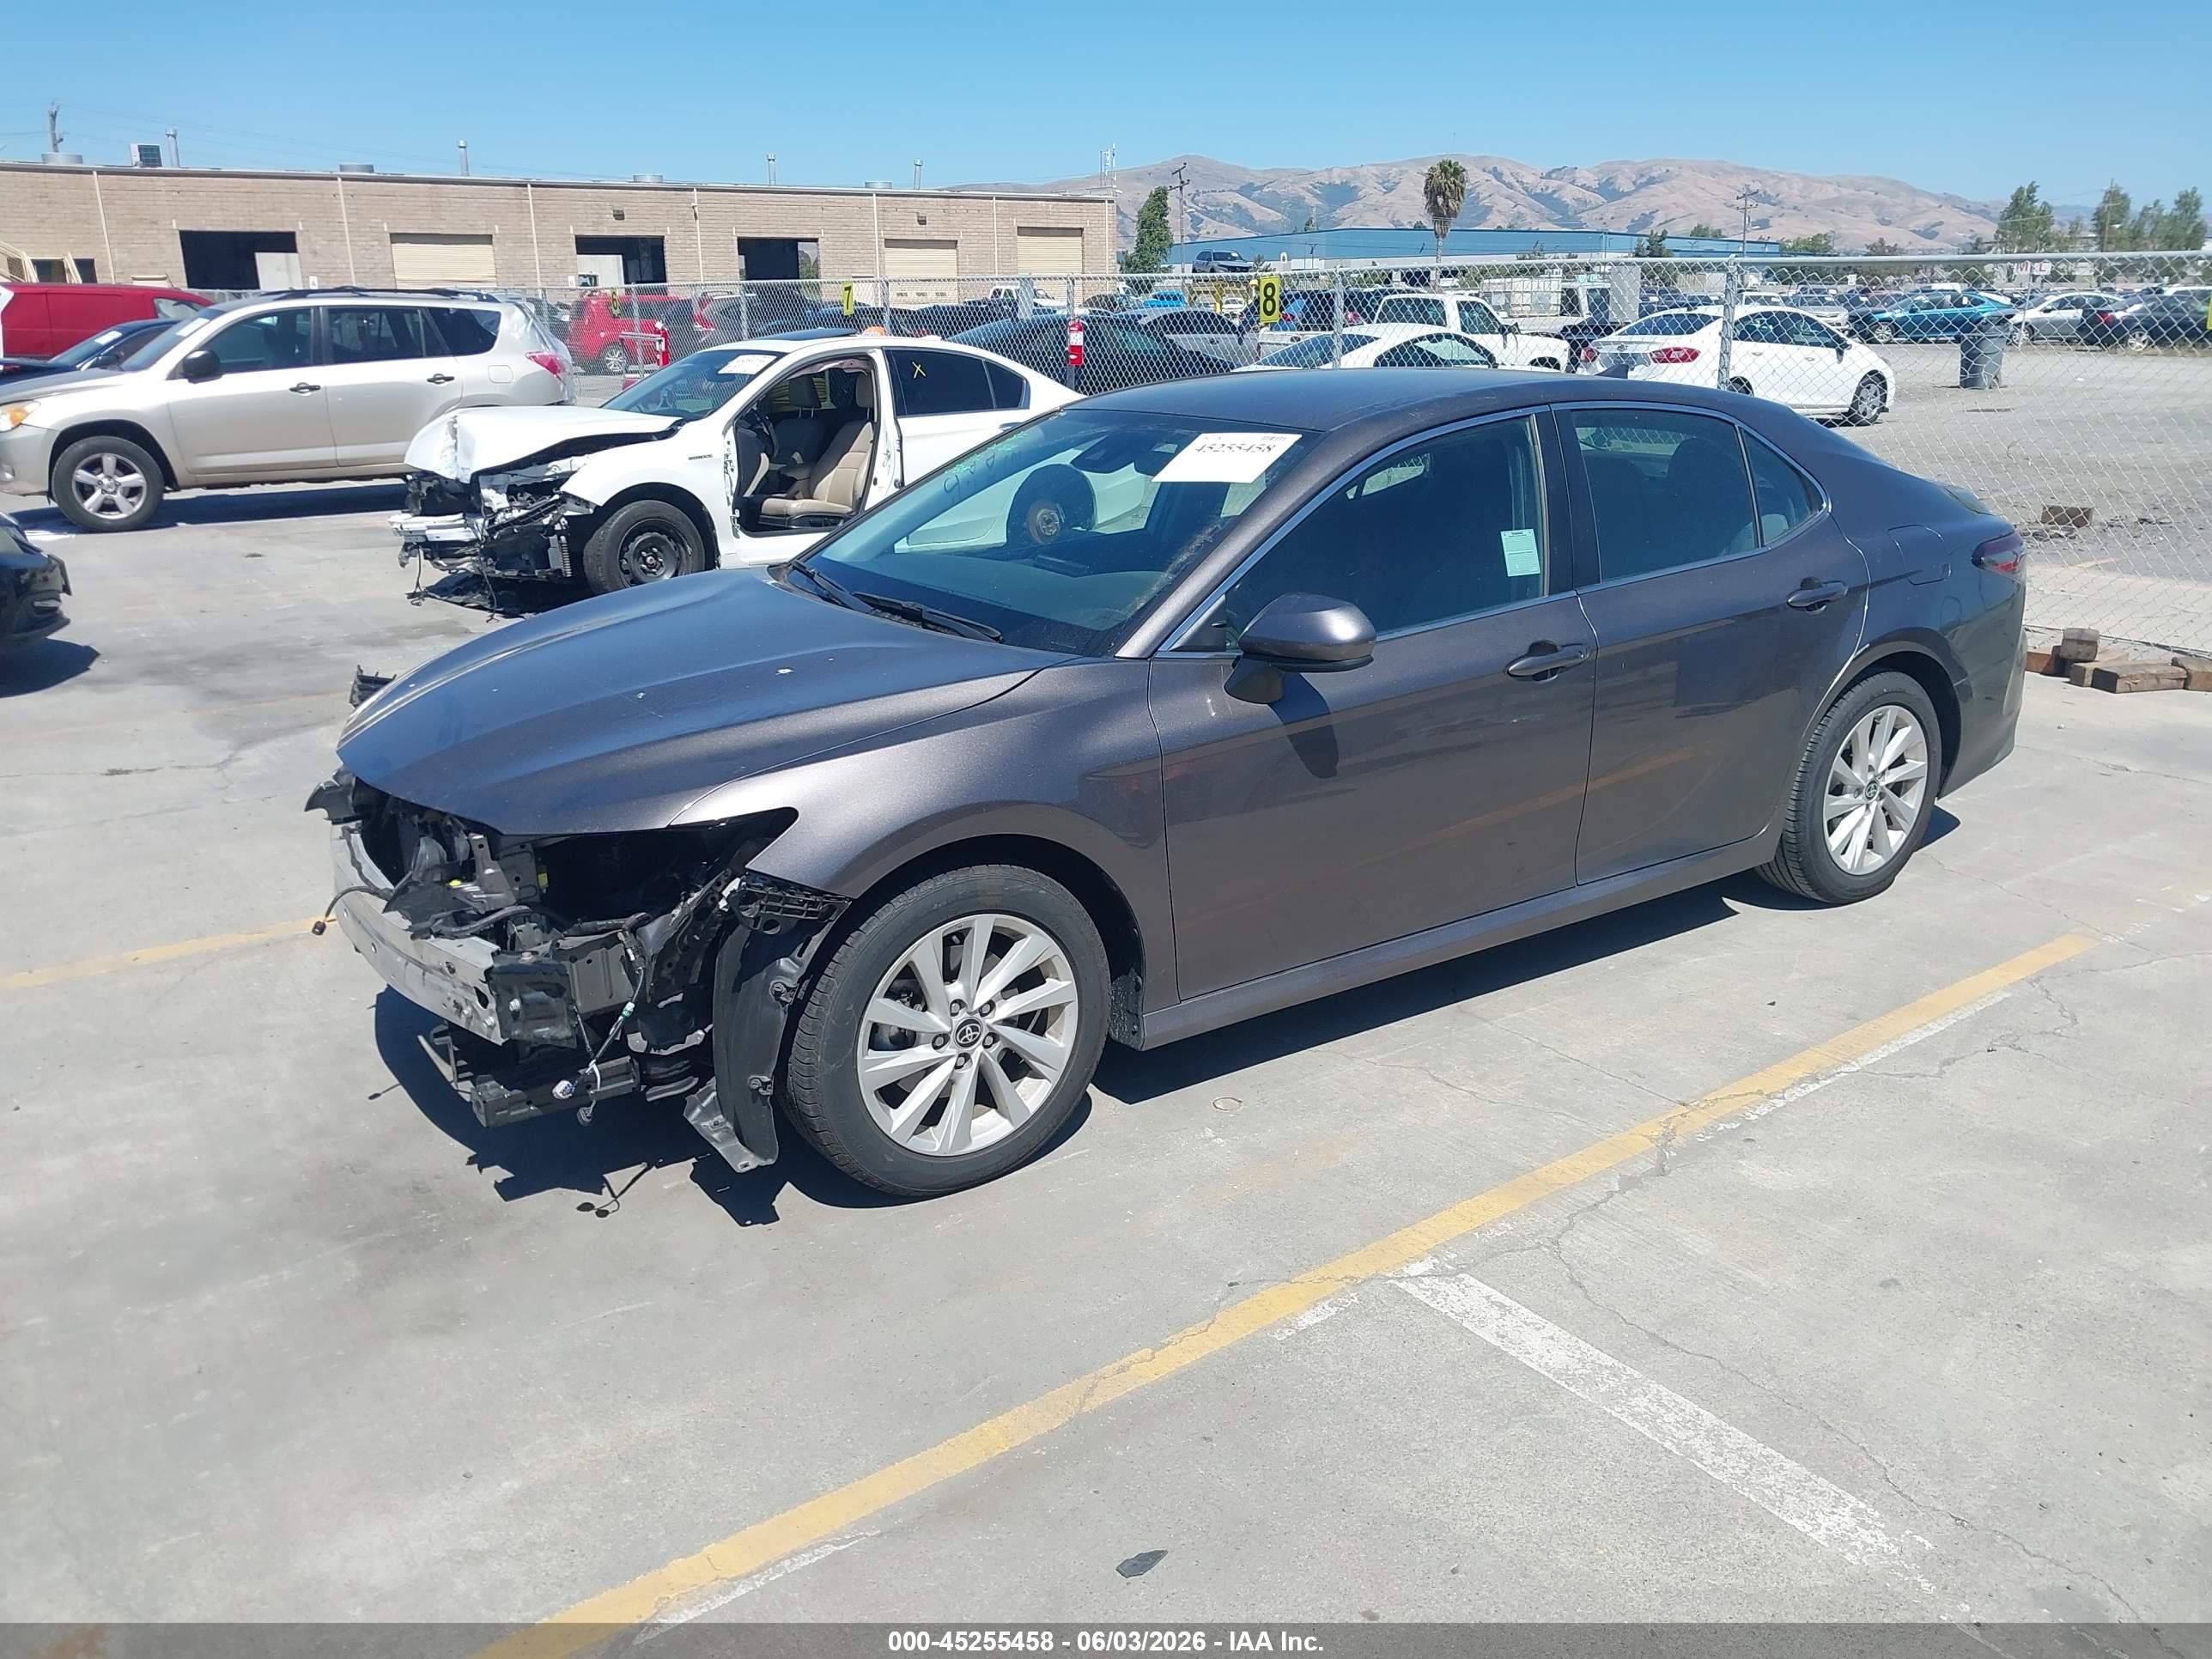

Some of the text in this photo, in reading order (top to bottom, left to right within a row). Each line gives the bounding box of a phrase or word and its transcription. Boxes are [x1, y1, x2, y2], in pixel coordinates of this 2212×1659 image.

[611, 291, 618, 311] 6
[844, 285, 852, 310] 7
[1262, 282, 1277, 317] 8
